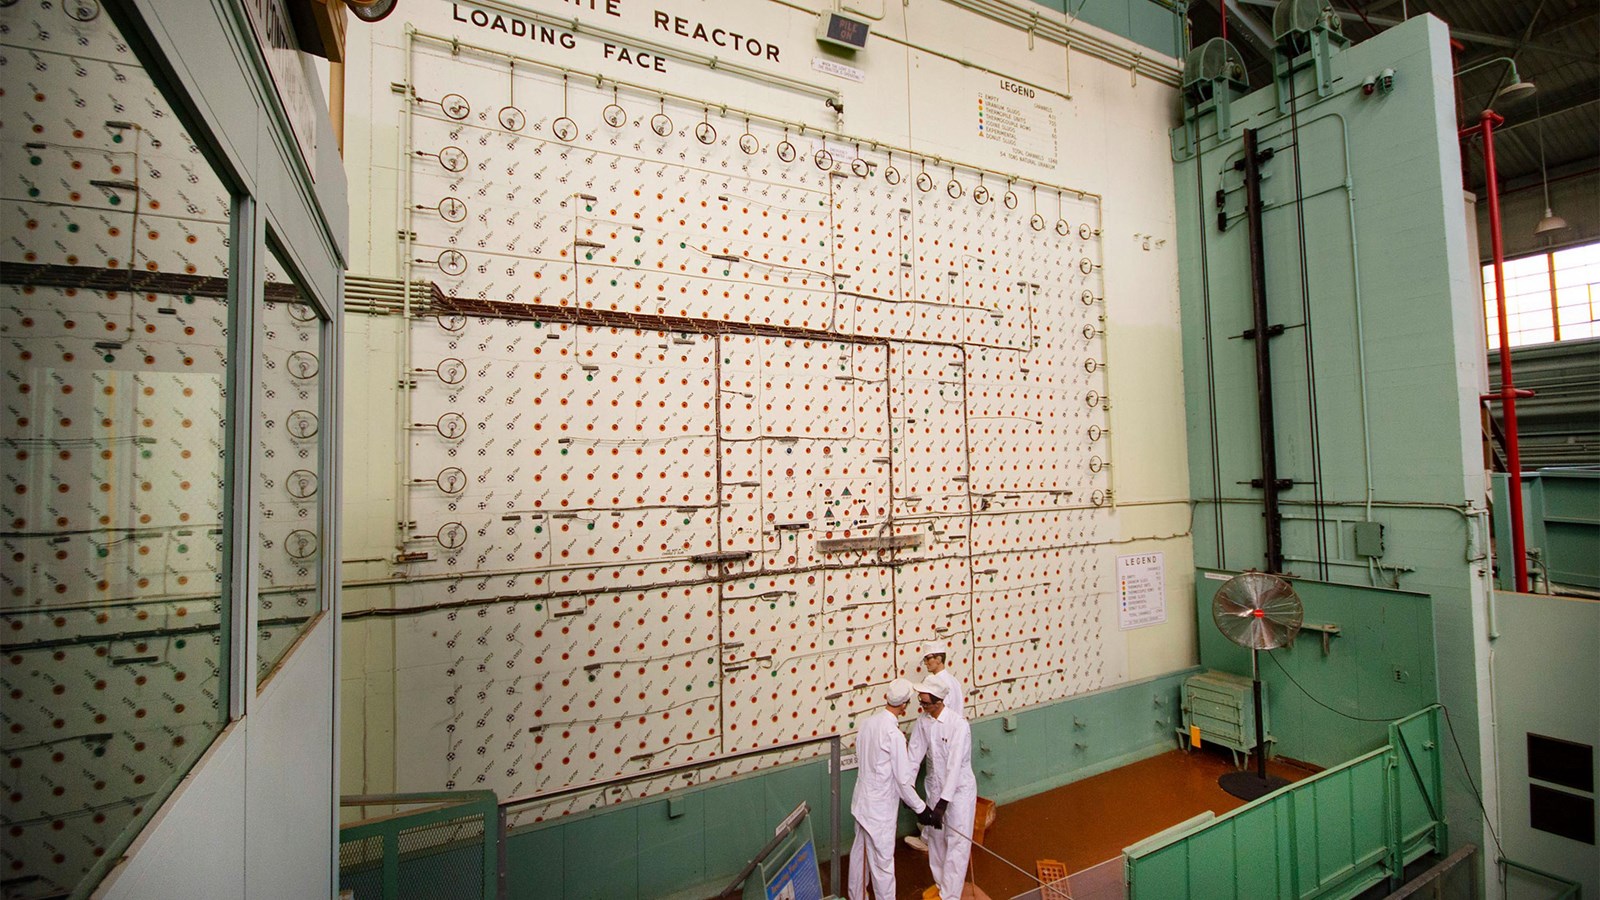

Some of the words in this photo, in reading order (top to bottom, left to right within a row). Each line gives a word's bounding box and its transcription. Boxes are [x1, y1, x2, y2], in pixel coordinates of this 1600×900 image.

[839, 20, 856, 33] PILE
[453, 3, 577, 50] LOADING
[603, 43, 668, 73] FACE
[654, 10, 782, 63] REACTOR
[840, 31, 852, 40] ON
[1000, 80, 1035, 98] LEGEND
[985, 101, 1004, 110] URANIUM
[1125, 556, 1157, 566] LEGEND
